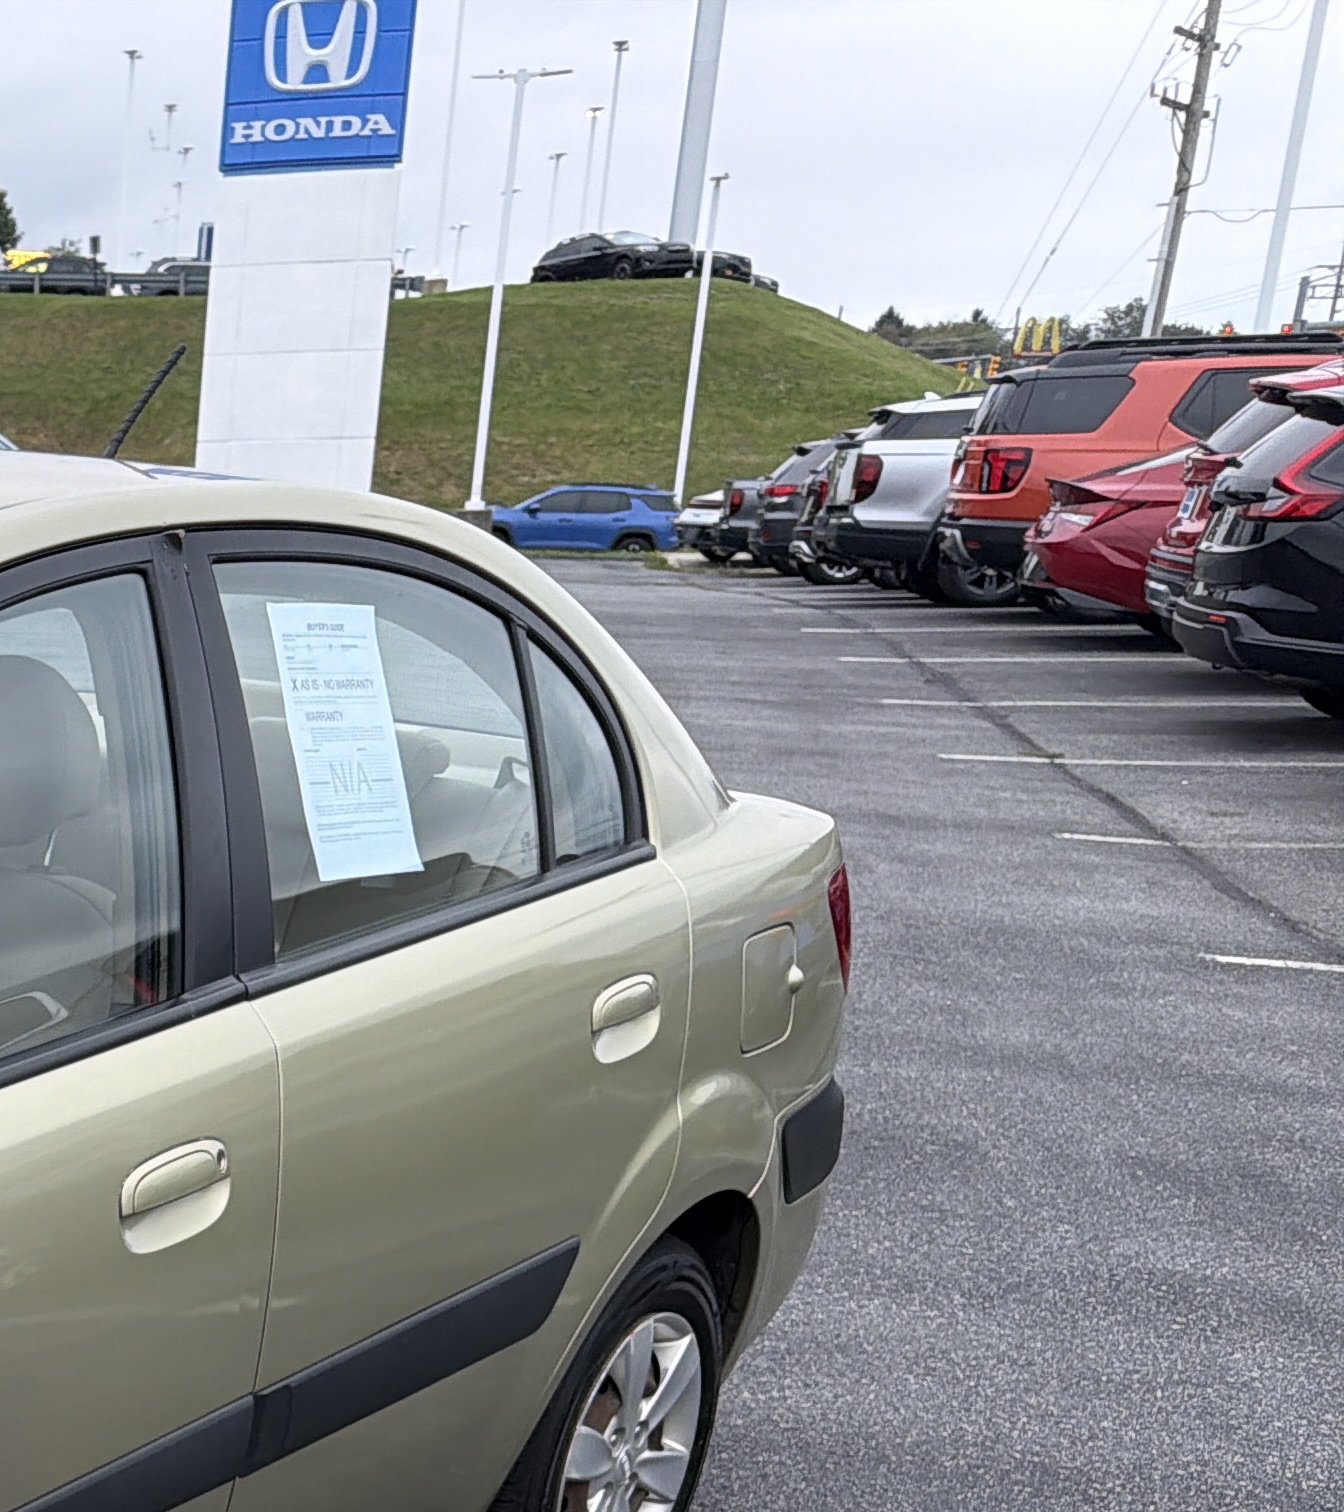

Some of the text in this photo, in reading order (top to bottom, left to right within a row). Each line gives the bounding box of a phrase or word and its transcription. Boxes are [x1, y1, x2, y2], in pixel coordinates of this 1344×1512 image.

[229, 113, 396, 144] HONDA
[300, 679, 311, 690] AS
[311, 679, 320, 690] IS
[323, 679, 334, 690] NO
[335, 678, 374, 690] WARRANTY
[305, 711, 343, 722] WARRANTY
[329, 761, 372, 794] N/A
